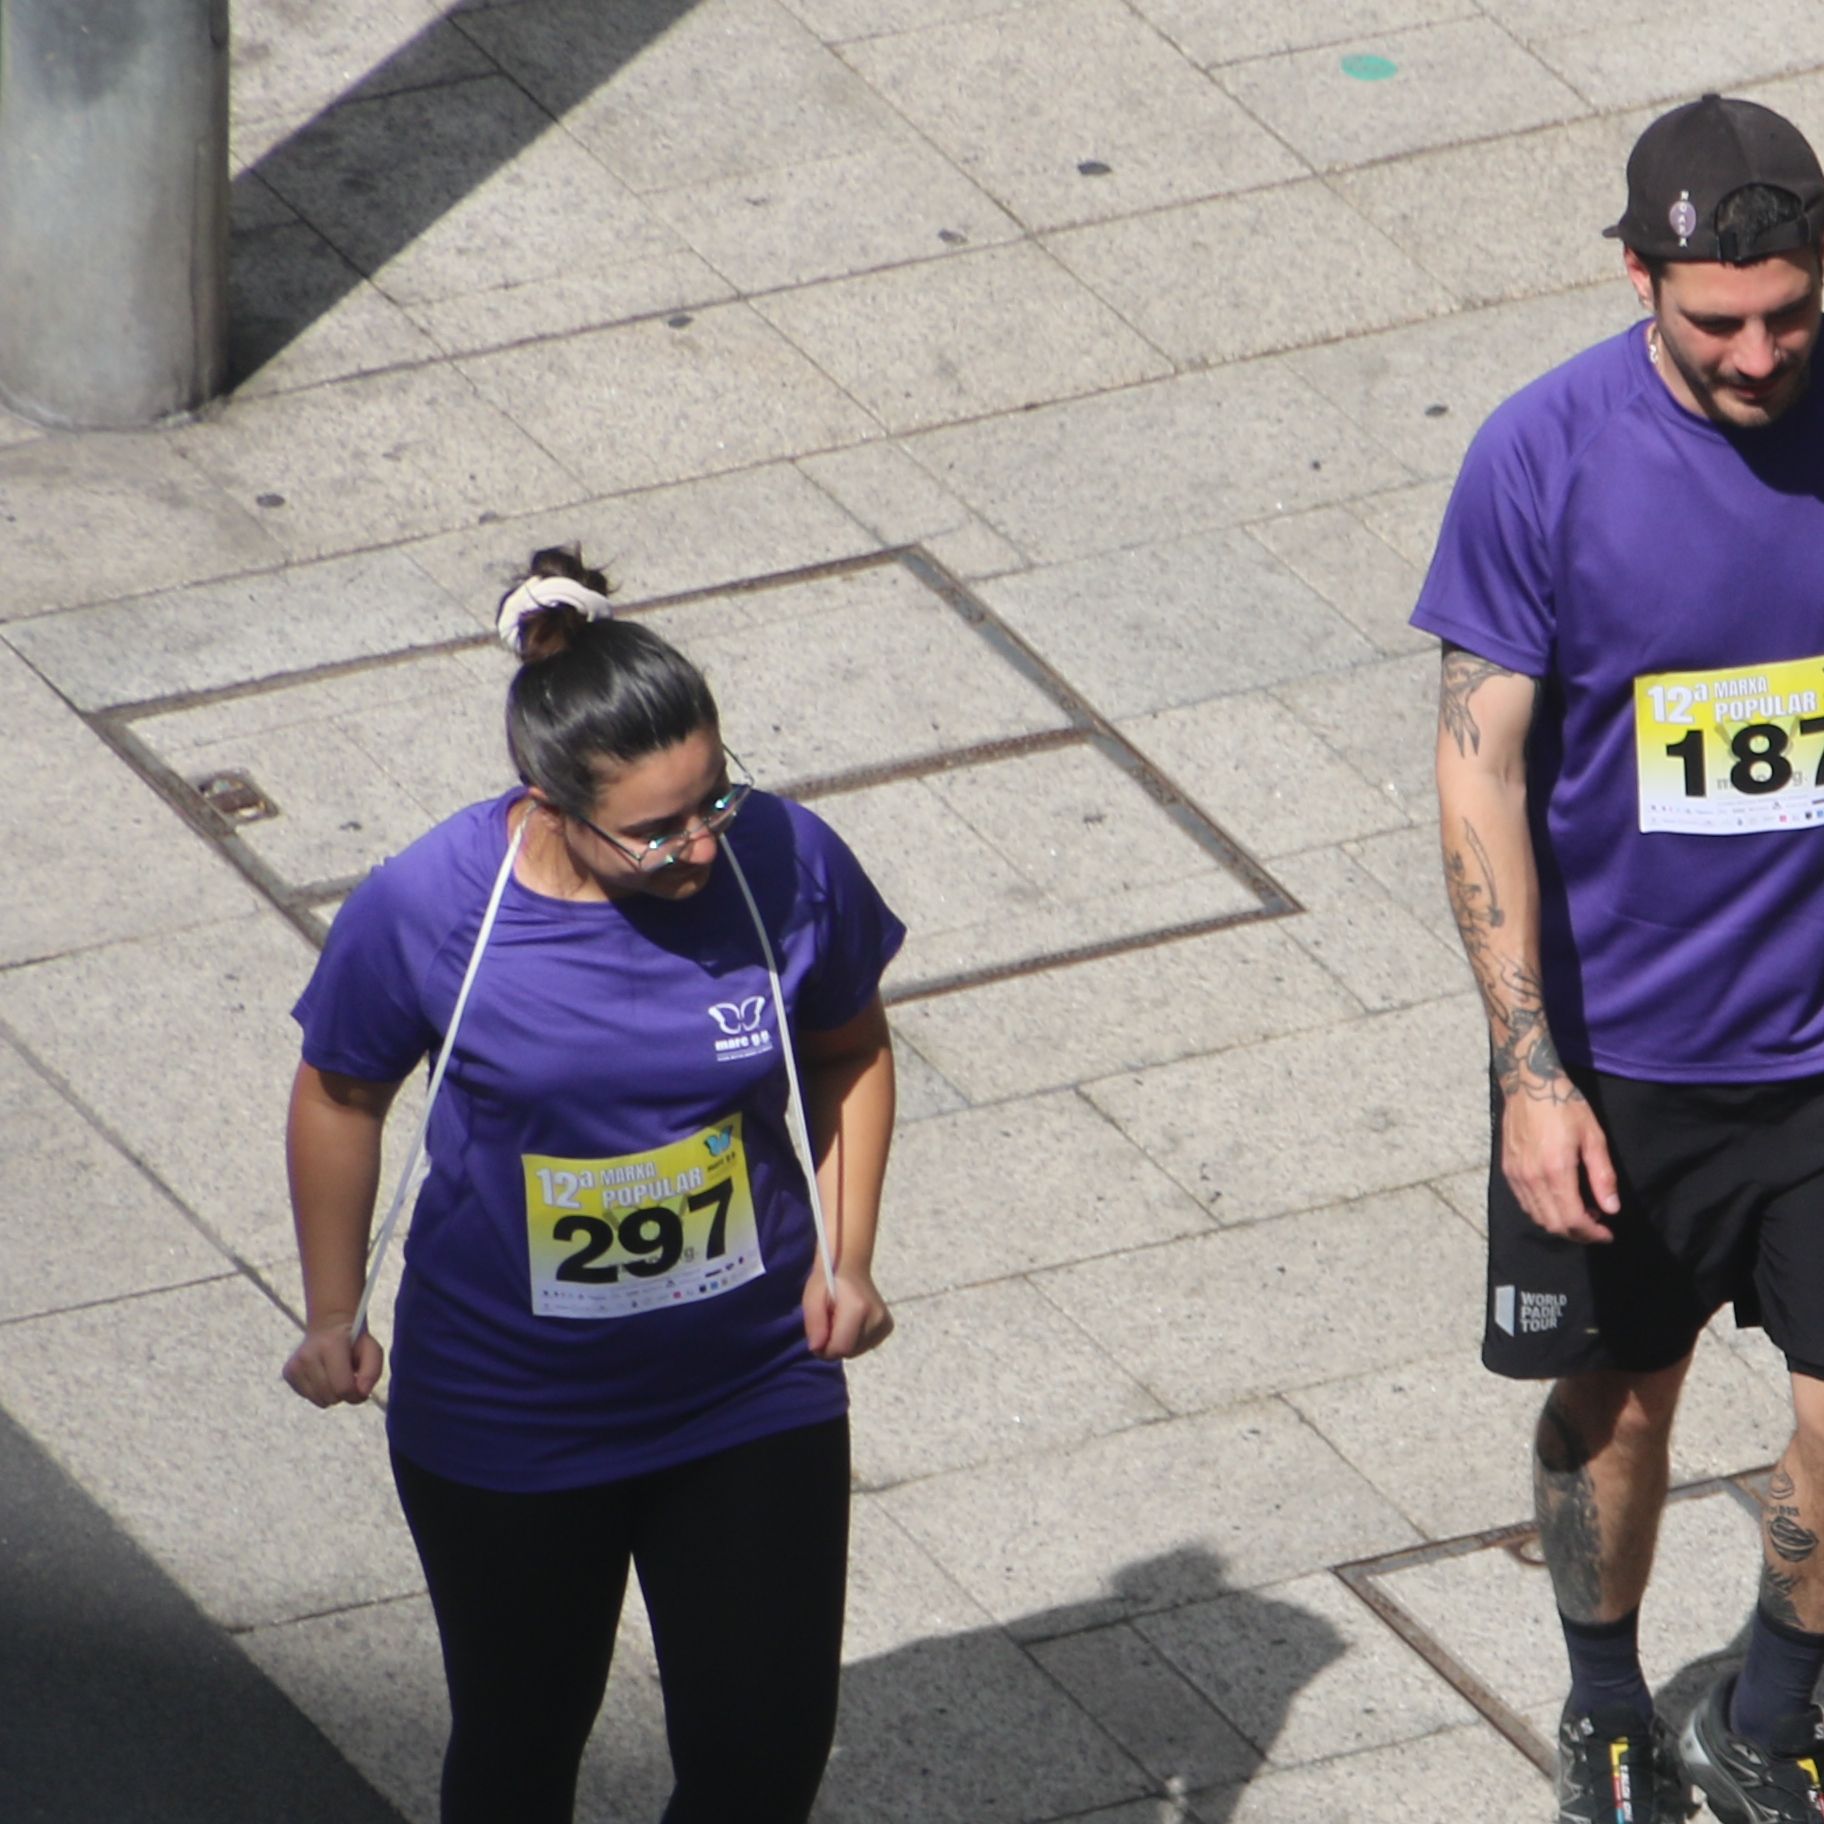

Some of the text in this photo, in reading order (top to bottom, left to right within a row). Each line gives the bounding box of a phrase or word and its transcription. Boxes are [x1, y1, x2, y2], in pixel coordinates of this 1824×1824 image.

[1714, 675, 1768, 699] MARXA
[1714, 690, 1818, 722] POPULAR
[601, 1161, 656, 1185] MARXA
[603, 1167, 704, 1209] POPULAR
[553, 1175, 733, 1284] 297
[1520, 1290, 1568, 1307] WORLD
[1520, 1305, 1563, 1319] PADEL
[1520, 1317, 1558, 1333] TOUR
